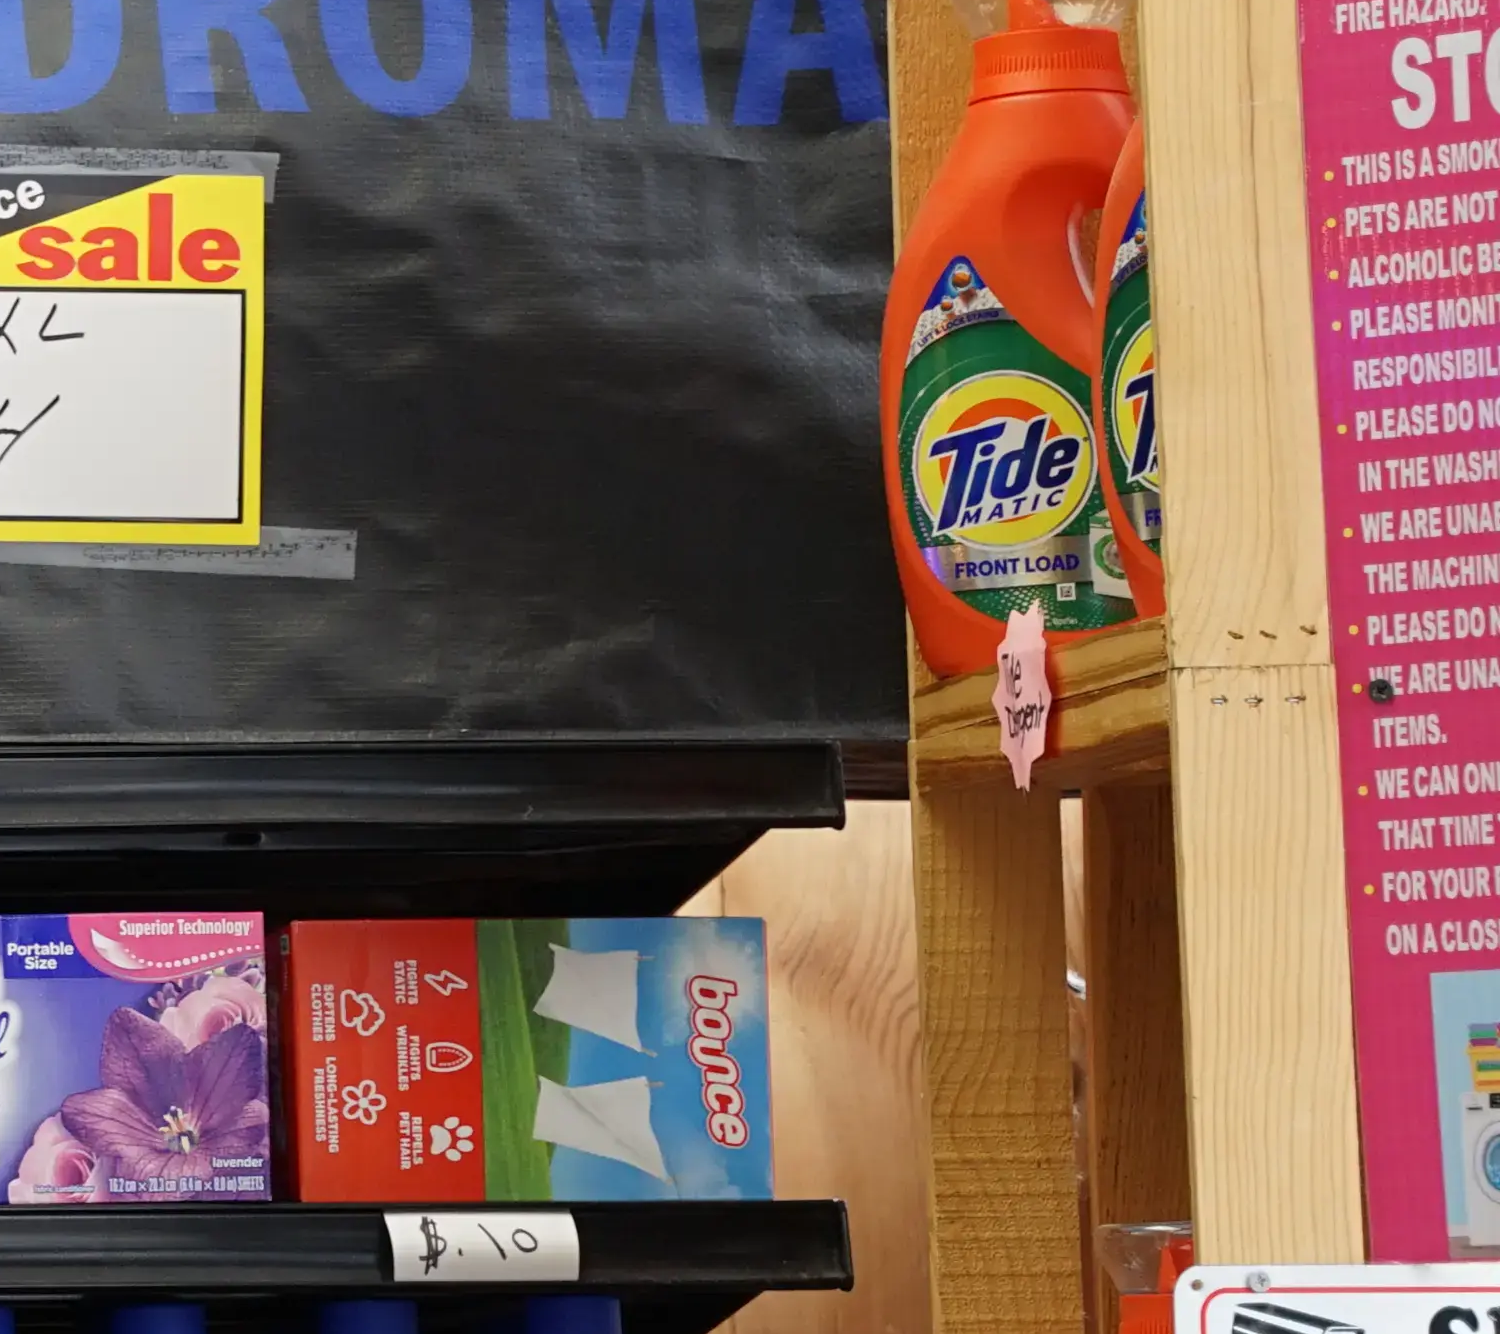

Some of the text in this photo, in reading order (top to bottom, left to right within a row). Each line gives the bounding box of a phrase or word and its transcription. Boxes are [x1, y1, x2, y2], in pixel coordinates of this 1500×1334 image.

[1336, 0, 1384, 34] FIRE
[1342, 152, 1391, 186] THIS
[1395, 146, 1413, 178] IS
[1420, 146, 1435, 169] A
[1345, 190, 1498, 237] PETS ARE NOT
[16, 193, 241, 283] sale
[1348, 244, 1473, 288] ALCOHOLIC
[930, 417, 1085, 535] Tide
[959, 488, 1065, 527] MATIC
[954, 553, 1079, 579] FRONT LOAD
[1372, 714, 1447, 748] ITEMS.
[1375, 765, 1460, 799] WE CAN
[1378, 814, 1496, 851] THAT TIME
[1382, 866, 1491, 902] FOR YOUR
[119, 920, 174, 938] Superior
[7, 942, 74, 957] Portable
[25, 956, 58, 970] Size
[394, 960, 406, 1004] STATIC
[408, 959, 419, 1005] FIGHTS
[324, 983, 336, 1042] SOFTENS
[688, 977, 747, 1147] bounce
